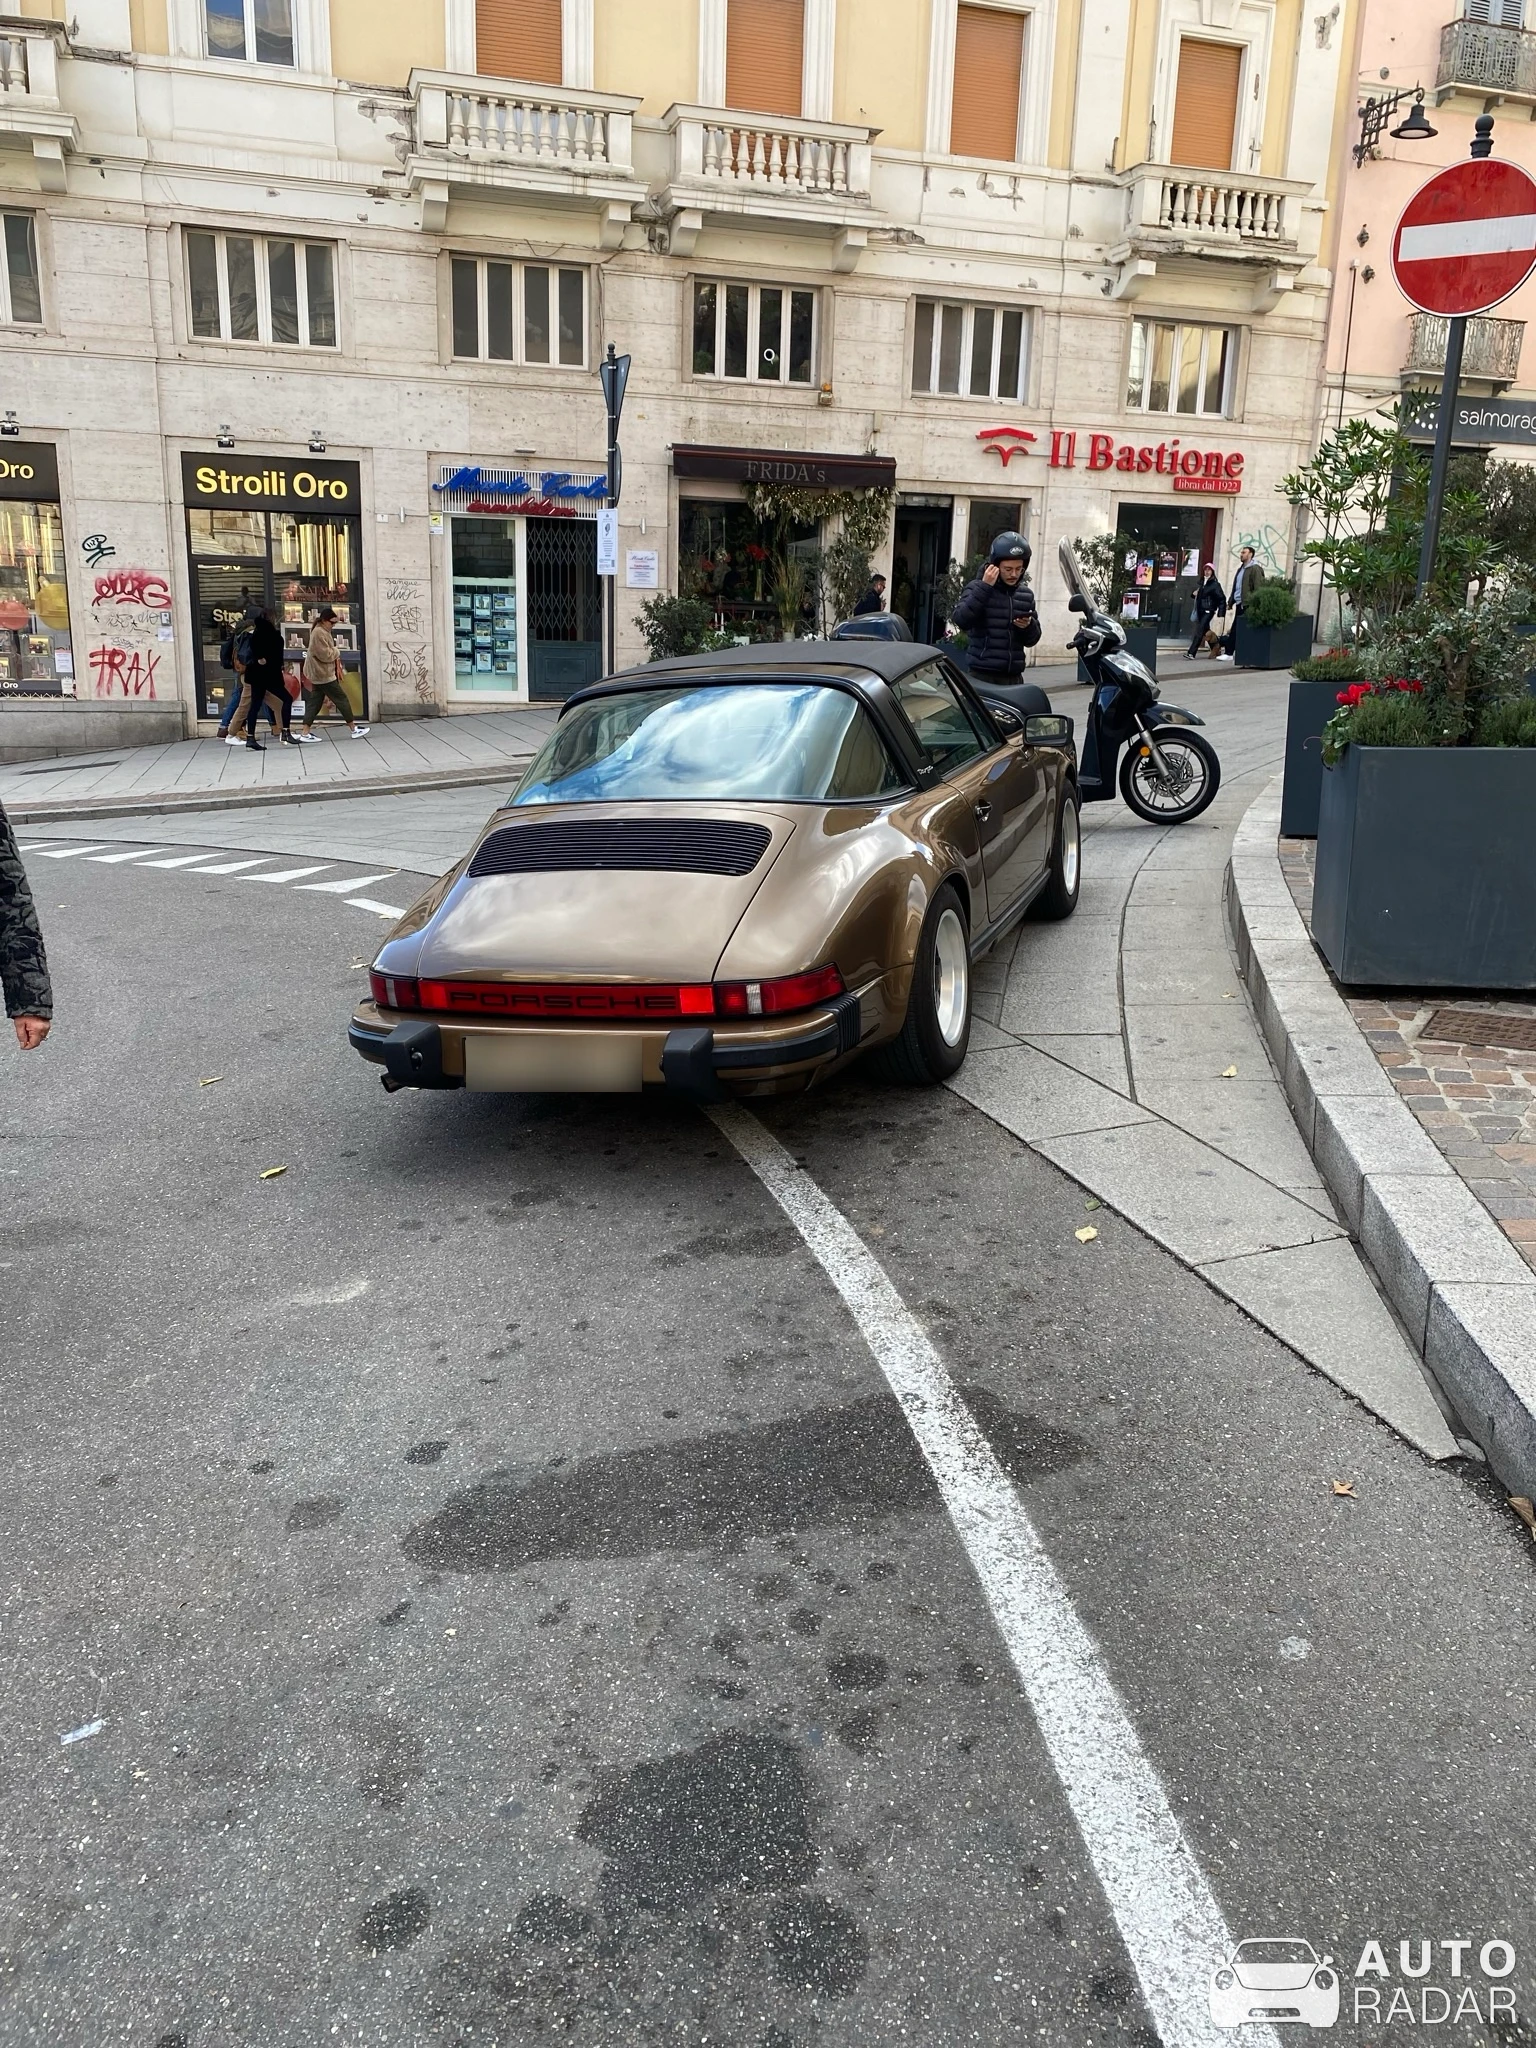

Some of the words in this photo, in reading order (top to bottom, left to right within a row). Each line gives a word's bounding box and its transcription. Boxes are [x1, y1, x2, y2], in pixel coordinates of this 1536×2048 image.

[1047, 431, 1077, 468] Il
[1086, 434, 1245, 477] Bastione
[196, 467, 287, 496] Stroili
[292, 472, 348, 500] Oro
[432, 467, 532, 495] Monte
[746, 461, 826, 482] FRIDA's
[1178, 479, 1200, 489] librai
[1202, 480, 1215, 490] dal
[1218, 481, 1238, 491] 1922
[450, 991, 677, 1009] PORSCHE
